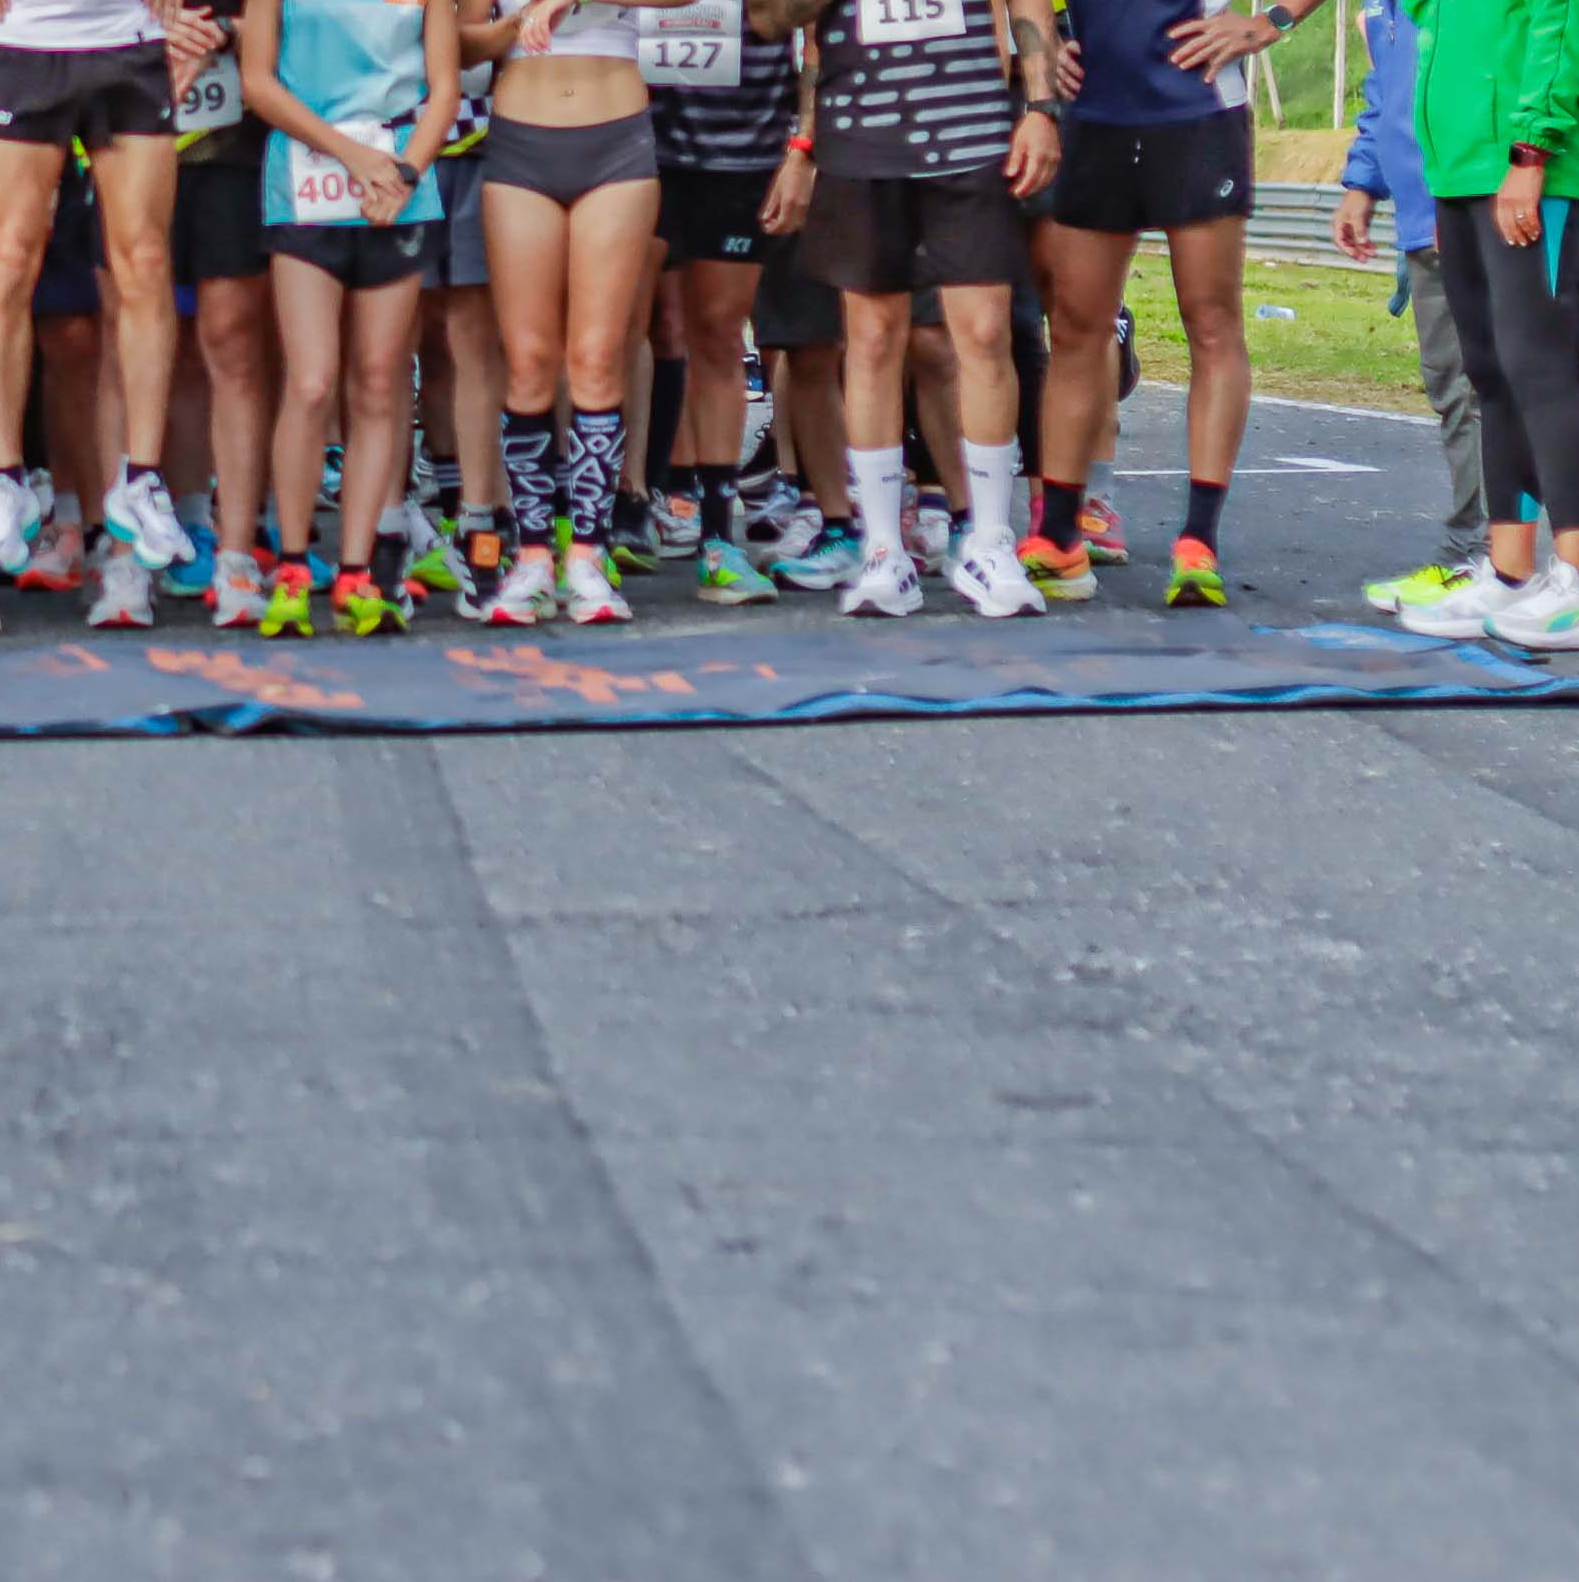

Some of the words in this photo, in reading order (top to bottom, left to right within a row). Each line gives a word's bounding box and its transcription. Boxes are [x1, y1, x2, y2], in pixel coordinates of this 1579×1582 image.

[654, 41, 723, 69] 127
[183, 81, 226, 115] 99
[298, 172, 366, 204] 406
